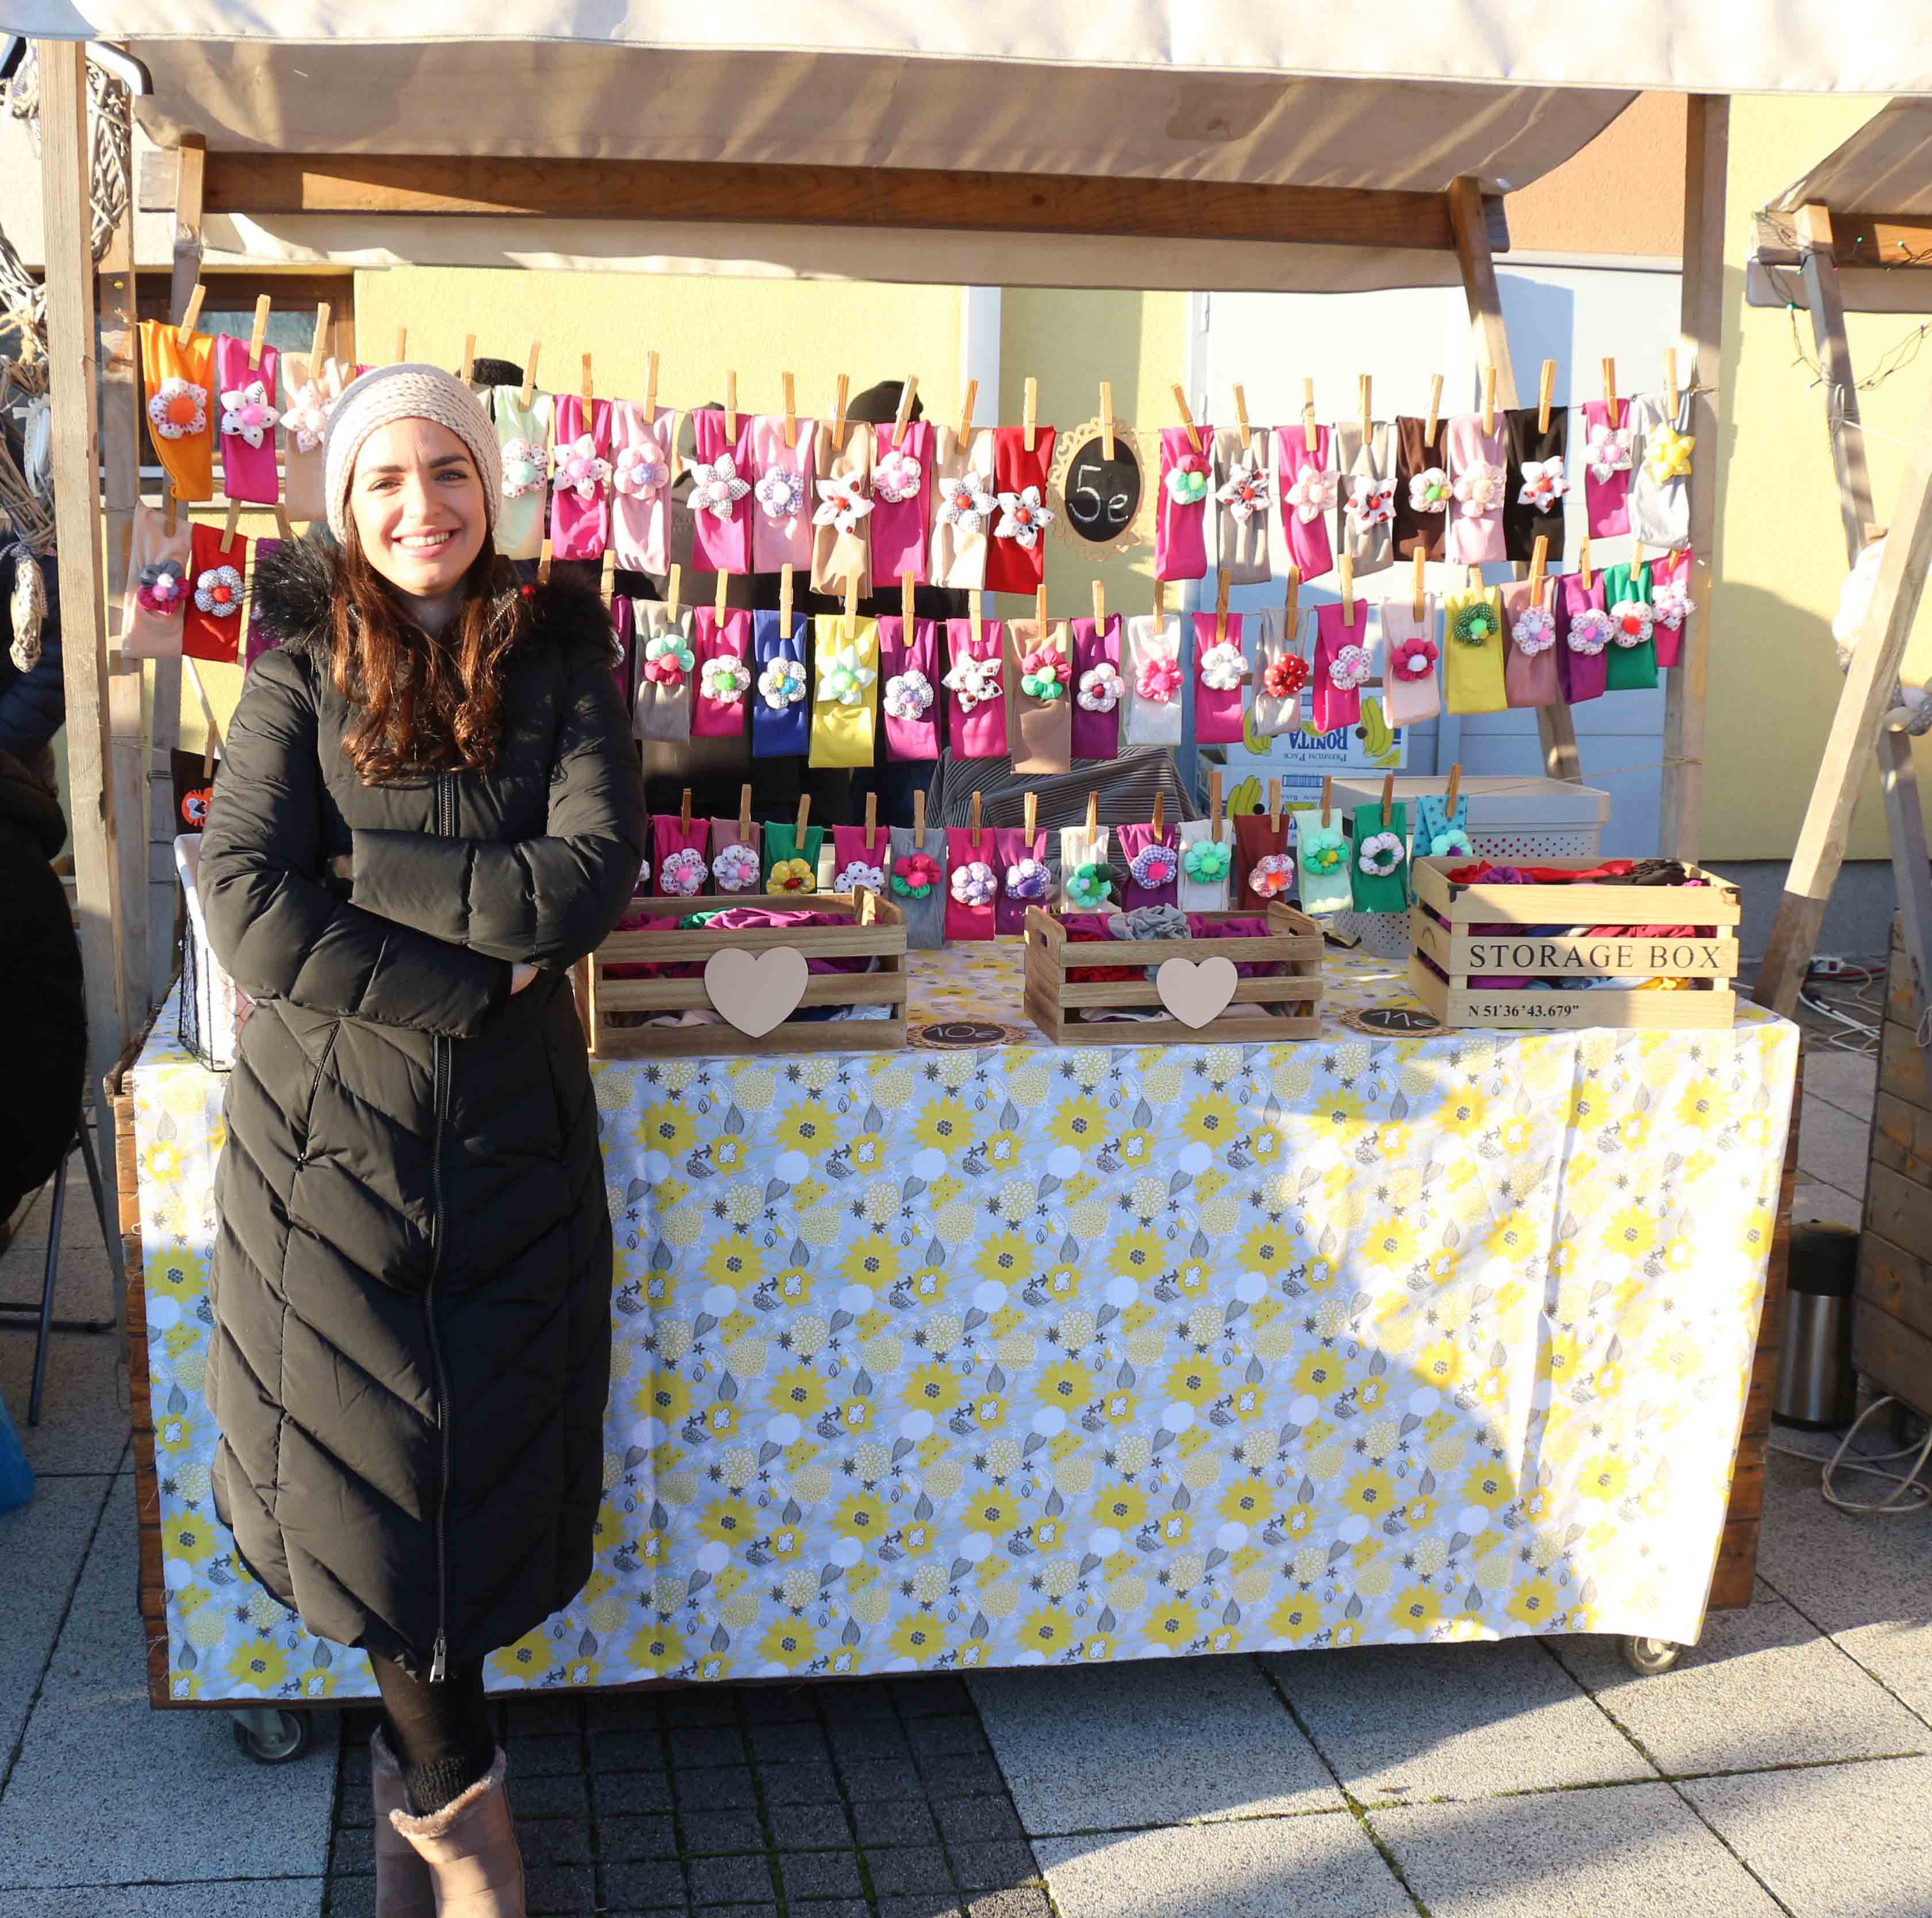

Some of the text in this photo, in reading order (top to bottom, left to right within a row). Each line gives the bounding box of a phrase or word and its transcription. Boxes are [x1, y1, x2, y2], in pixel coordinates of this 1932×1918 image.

[1470, 944, 1721, 969] STORAGE BOX
[1469, 1005, 1479, 1016] N
